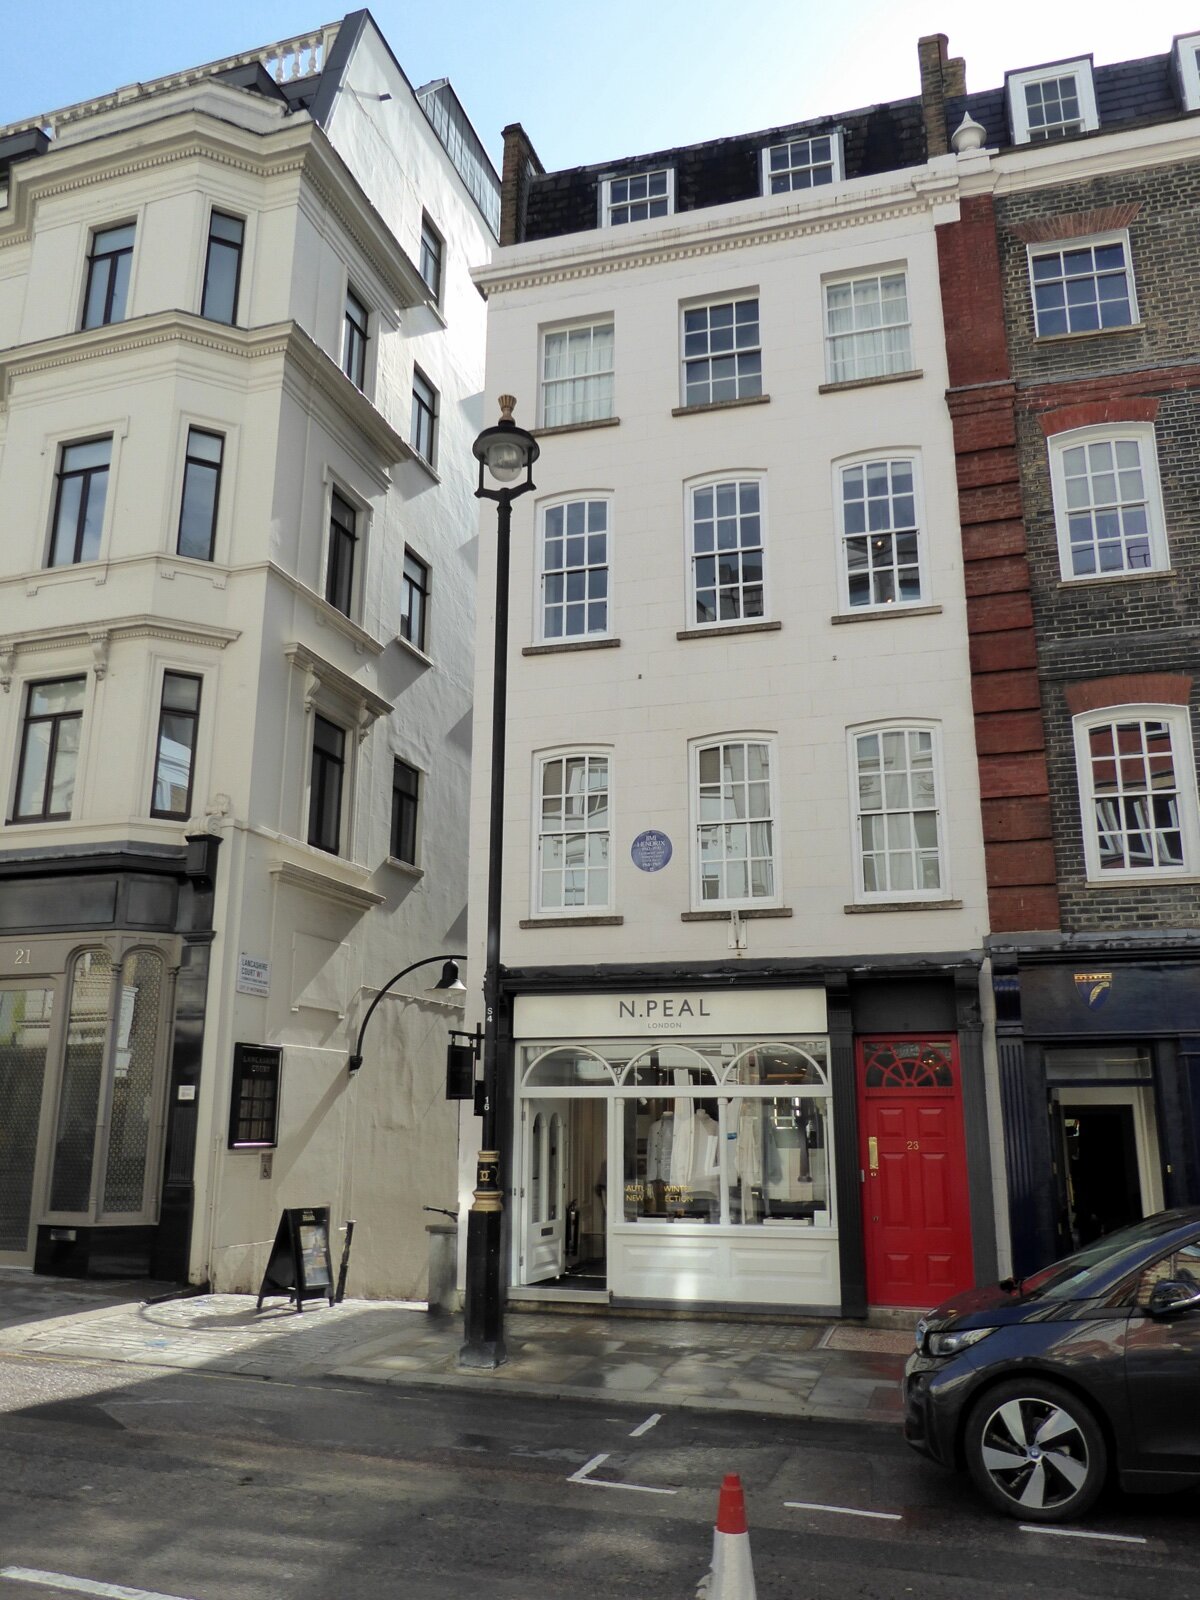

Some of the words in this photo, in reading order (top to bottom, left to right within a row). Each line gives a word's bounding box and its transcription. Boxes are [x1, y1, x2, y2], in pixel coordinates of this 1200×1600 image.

[15, 949, 30, 964] 21
[241, 959, 268, 971] LANCASHIRE
[241, 967, 256, 977] COURT
[906, 1141, 919, 1150] 23
